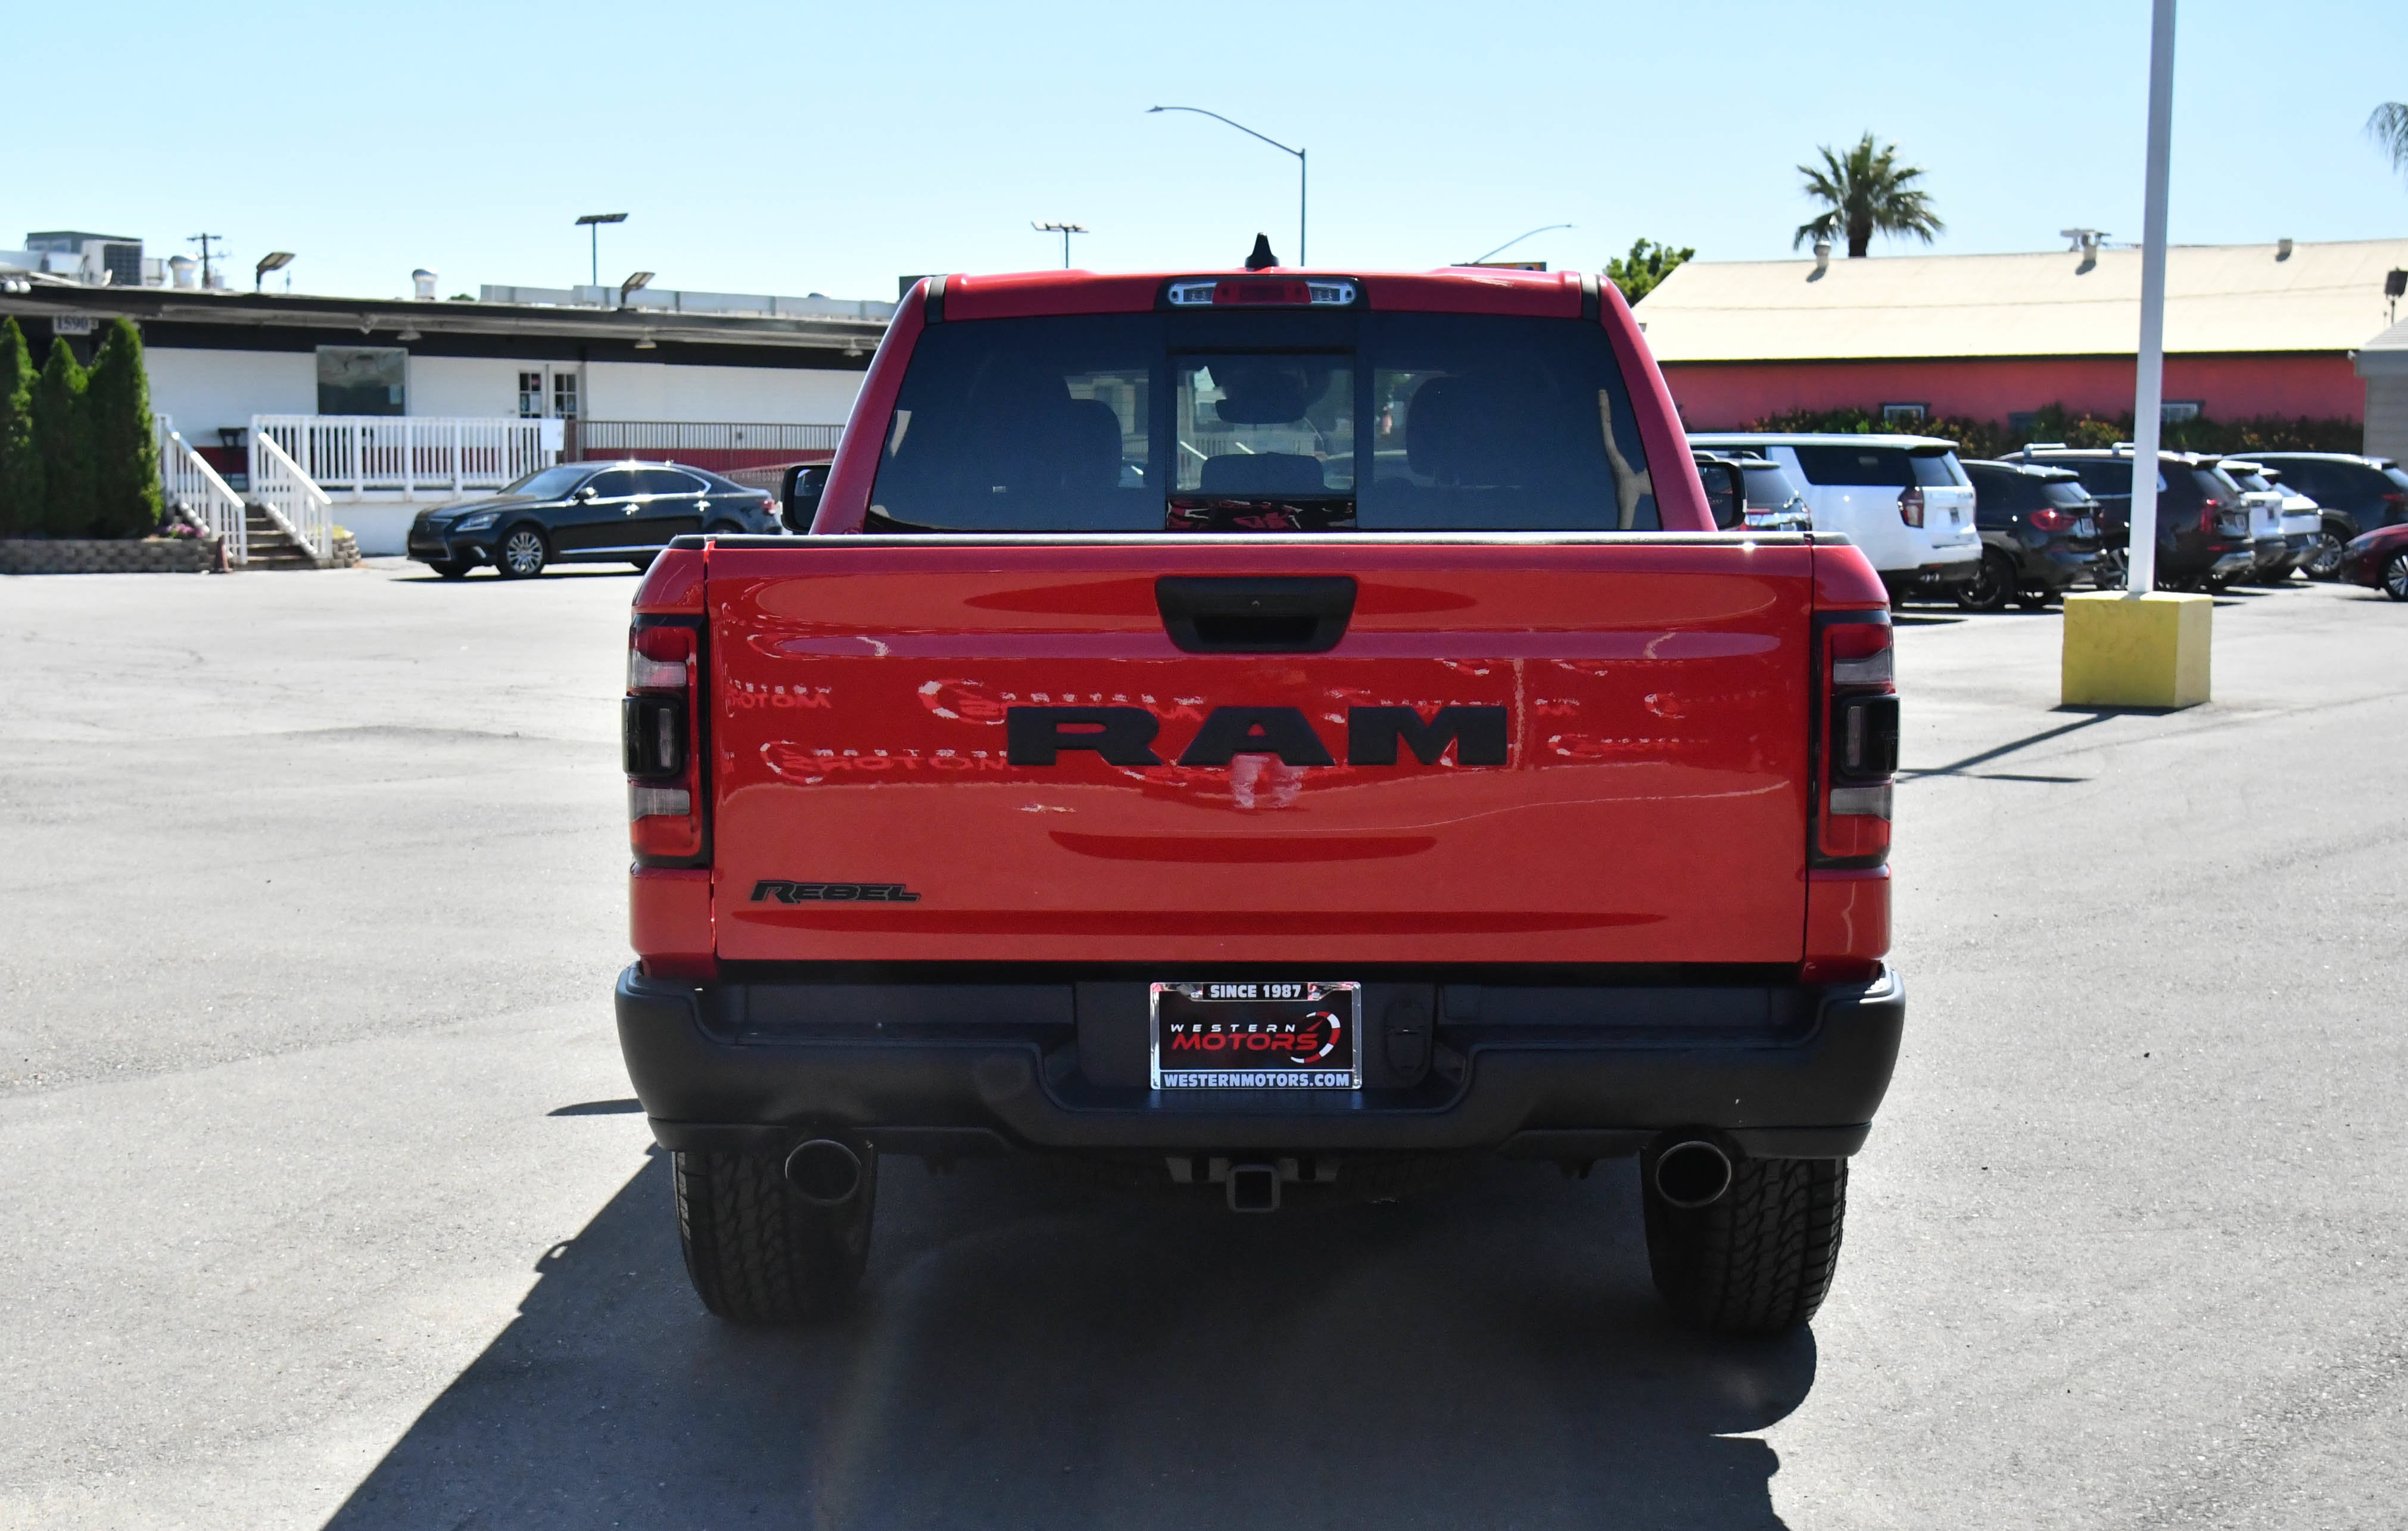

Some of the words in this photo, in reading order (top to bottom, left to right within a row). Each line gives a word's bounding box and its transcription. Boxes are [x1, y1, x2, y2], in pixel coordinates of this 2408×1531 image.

[1007, 707, 1508, 766] RAM
[749, 880, 921, 904] REBEL
[1210, 985, 1257, 998] SINCE
[1263, 984, 1301, 998] 1987
[1170, 1023, 1295, 1033] WESTERN
[1172, 1033, 1319, 1050] MOTORS
[1164, 1073, 1350, 1087] WESTERNMOTORS.COM
